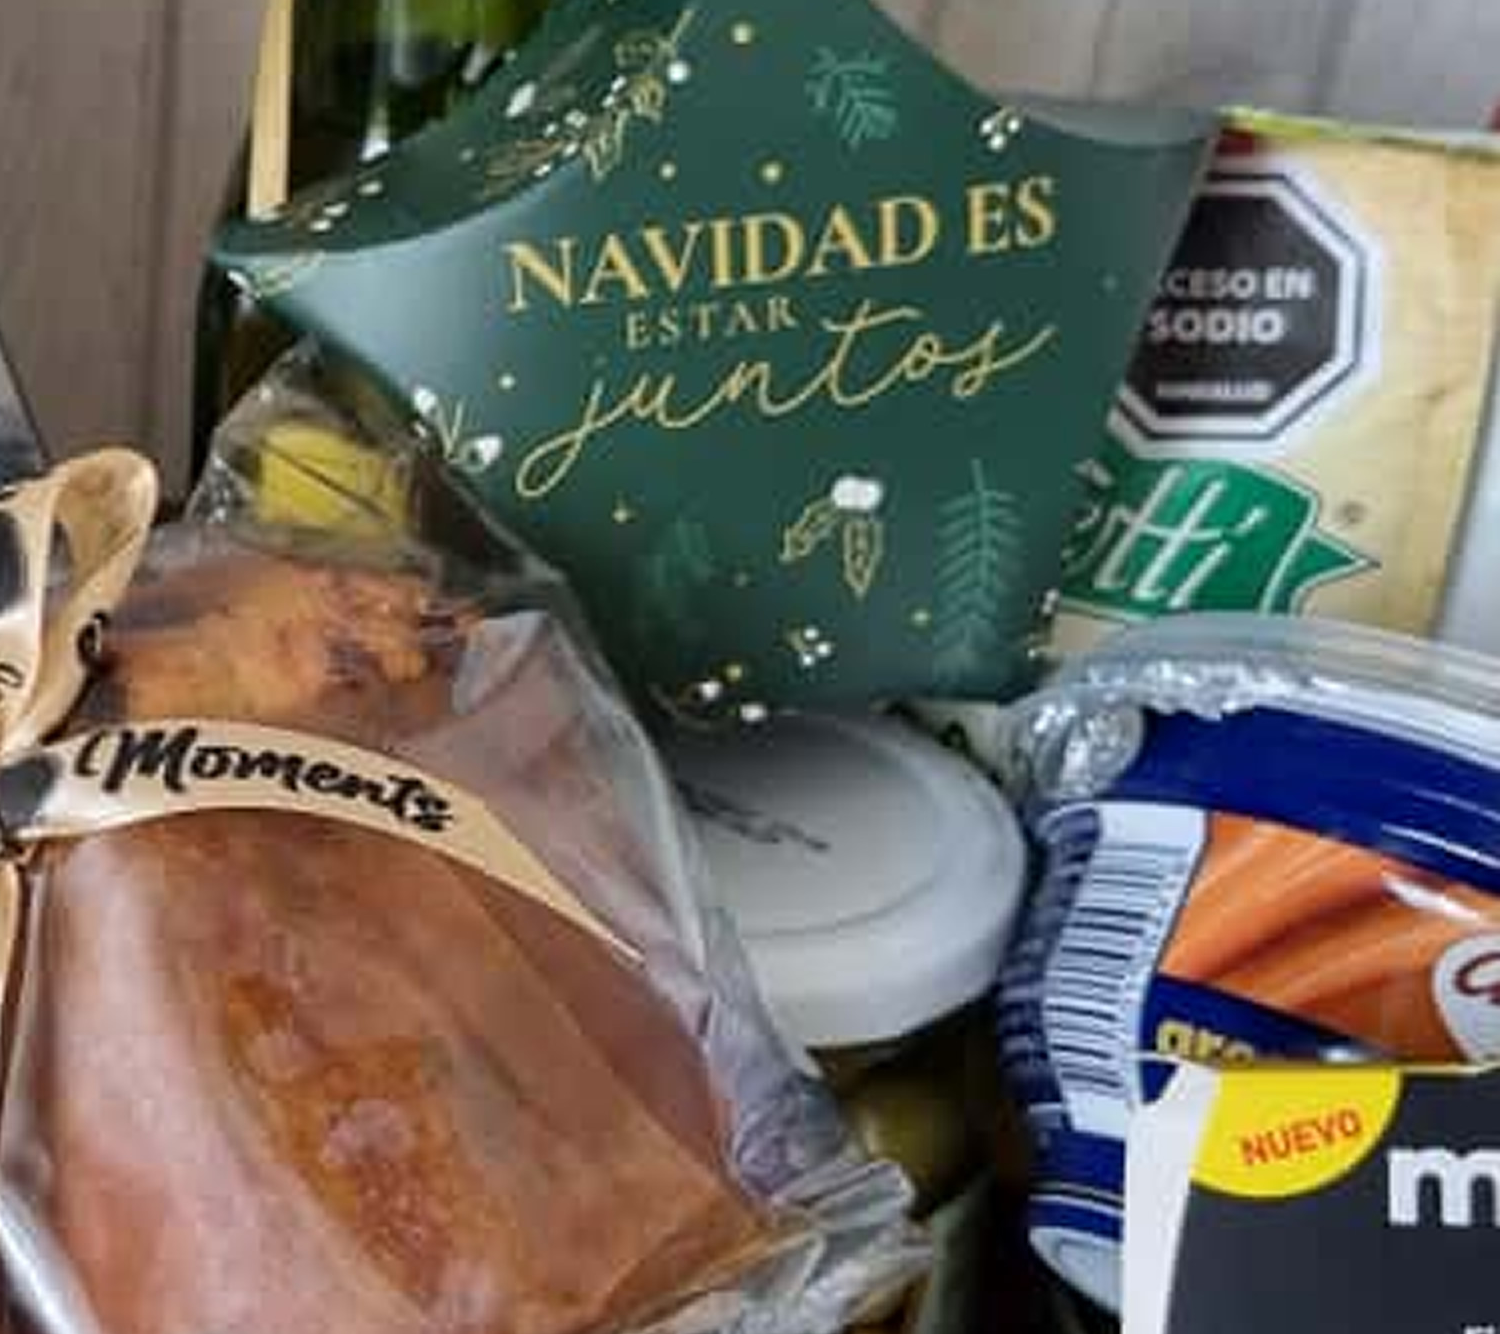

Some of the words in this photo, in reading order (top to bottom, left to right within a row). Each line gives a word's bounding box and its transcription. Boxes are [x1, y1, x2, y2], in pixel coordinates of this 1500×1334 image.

[507, 195, 940, 313] NAVIDAD
[964, 175, 1058, 255] ES
[1155, 267, 1257, 299] CESO
[625, 295, 798, 350] ESTAR
[1149, 308, 1287, 345] SODIO
[516, 299, 1056, 497] juntos
[73, 726, 454, 833] Moments
[1239, 1108, 1363, 1166] NUEVO
